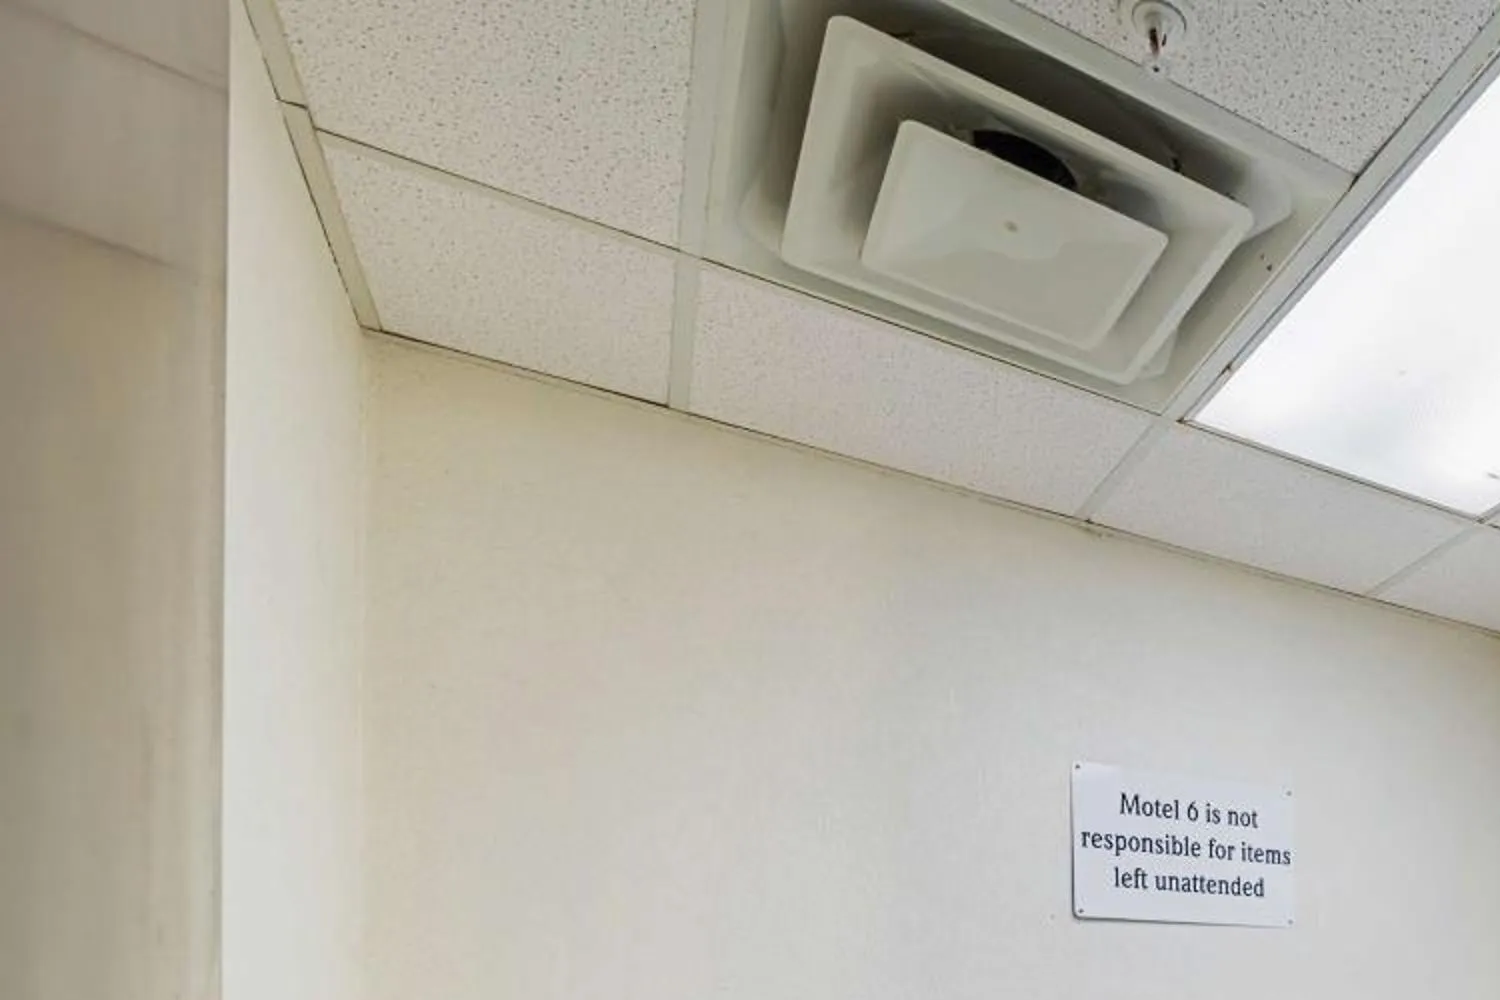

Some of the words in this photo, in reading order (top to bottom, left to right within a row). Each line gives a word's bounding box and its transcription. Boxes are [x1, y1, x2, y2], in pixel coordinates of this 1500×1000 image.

[1119, 792, 1180, 820] Motel
[1187, 801, 1199, 822] 6
[1205, 803, 1222, 825] is
[1228, 810, 1260, 829] not
[1081, 831, 1202, 858] responsible
[1208, 838, 1236, 862] for
[1241, 842, 1292, 866] items
[1114, 867, 1149, 890] left
[1155, 874, 1266, 898] unattended
